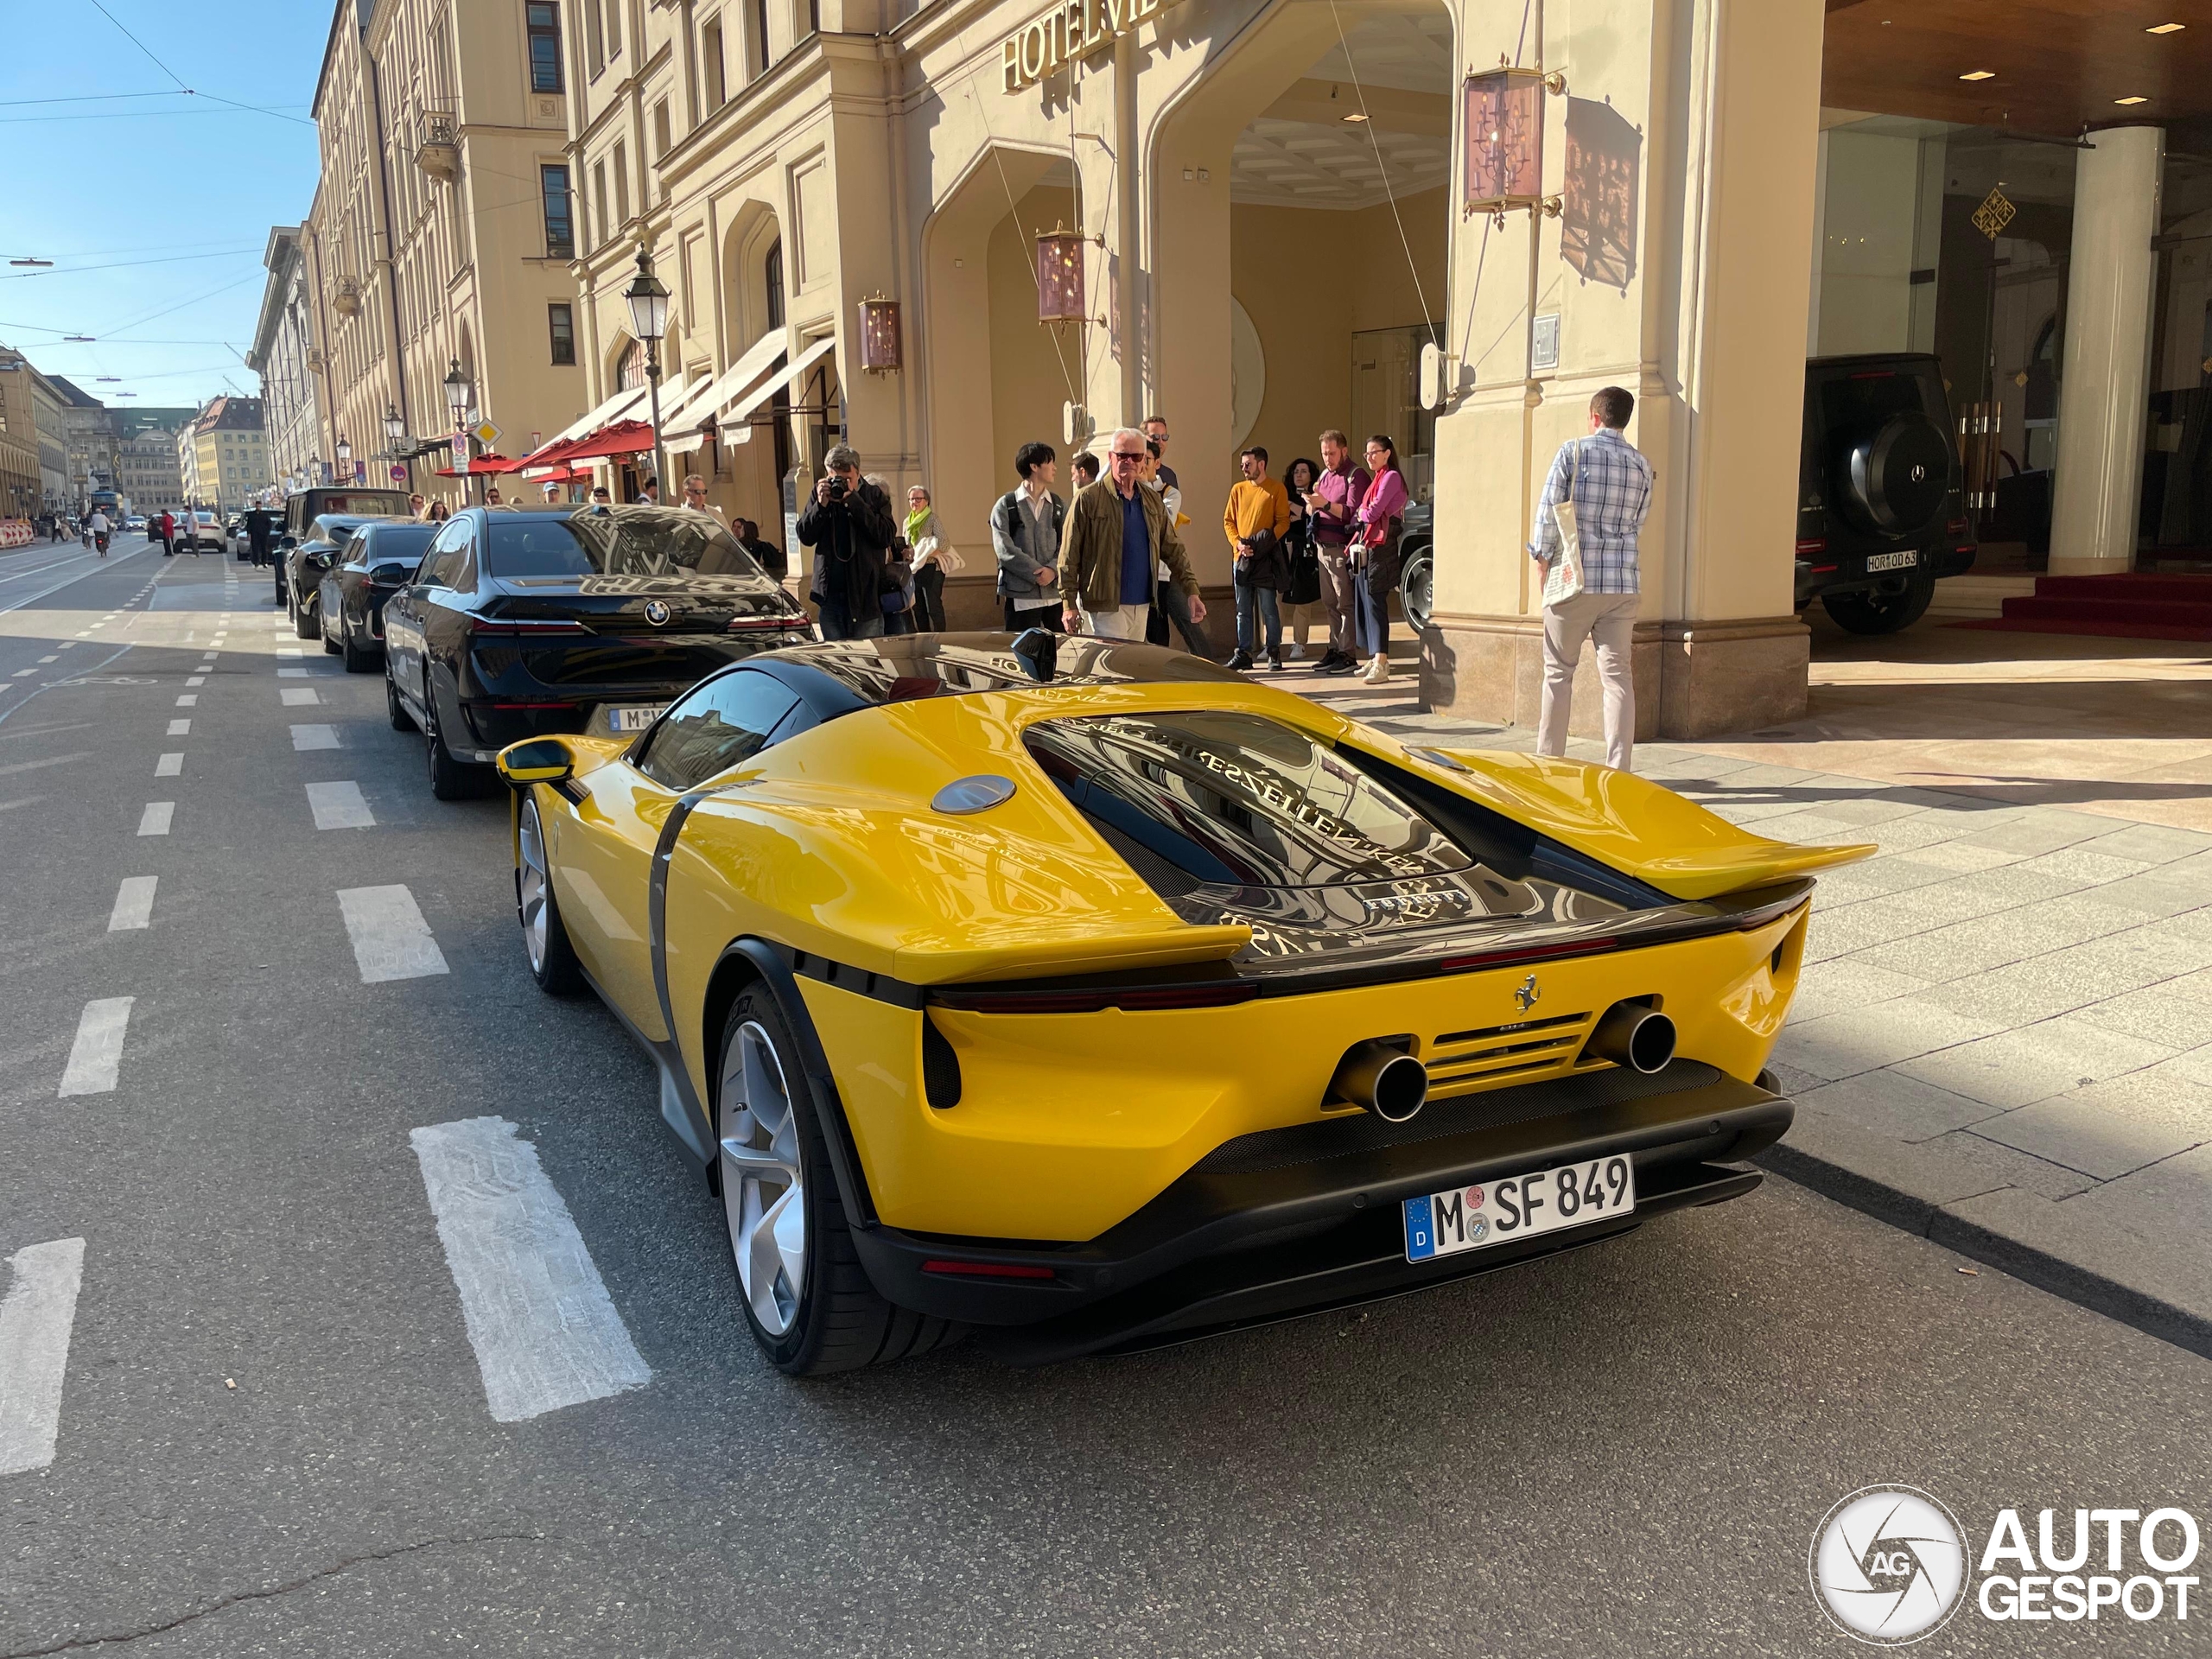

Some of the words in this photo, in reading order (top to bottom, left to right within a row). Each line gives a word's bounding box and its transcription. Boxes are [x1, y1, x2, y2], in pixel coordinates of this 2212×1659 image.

[1001, 0, 1102, 95] HOTEL
[1868, 556, 1885, 570] HOR
[1905, 551, 1916, 565] 63
[627, 711, 639, 728] M
[1363, 889, 1469, 912] Ferrari
[1435, 1192, 1464, 1246] M
[1495, 1174, 1545, 1231] SF
[1557, 1158, 1628, 1217] 849
[1416, 1231, 1426, 1247] D
